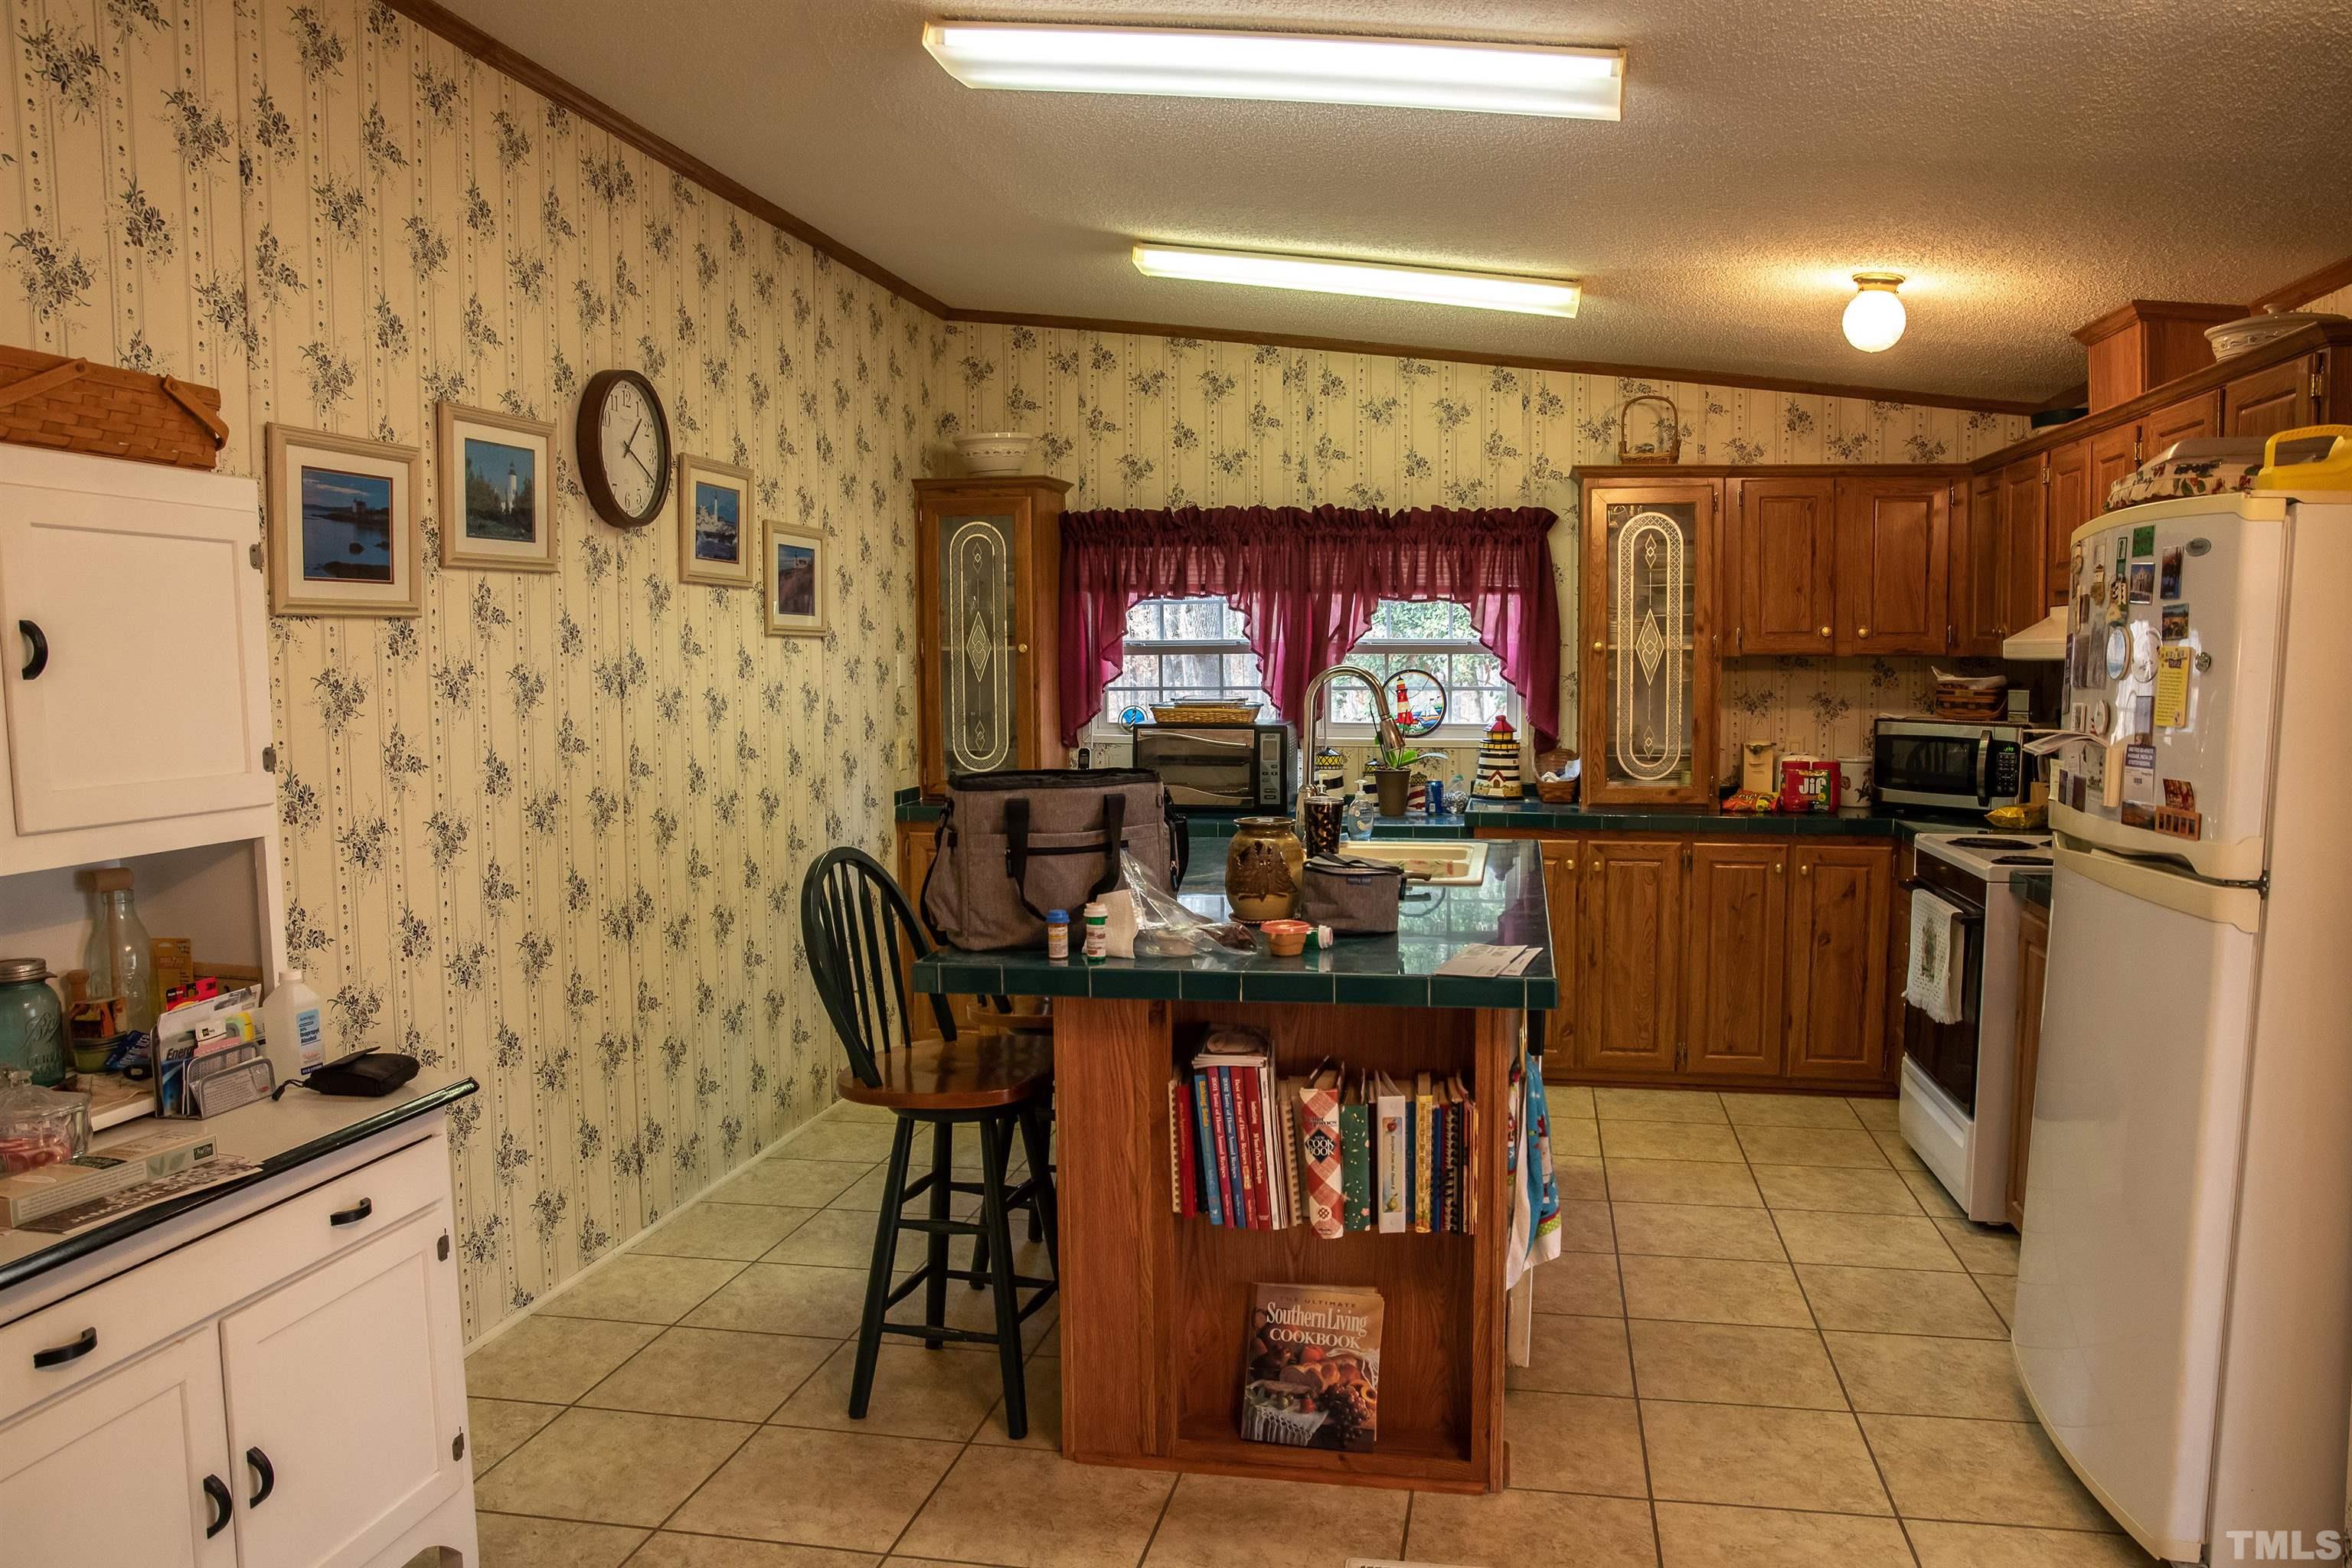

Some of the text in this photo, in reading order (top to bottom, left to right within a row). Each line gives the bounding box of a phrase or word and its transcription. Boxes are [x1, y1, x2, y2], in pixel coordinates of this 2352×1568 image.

[610, 394, 618, 411] 11
[622, 390, 631, 408] 12
[635, 401, 640, 417] 1
[603, 410, 610, 427] 10
[644, 421, 649, 437] 2
[649, 449, 654, 465] 3
[625, 492, 630, 509] 6
[636, 489, 642, 505] 5
[1798, 778, 1826, 794] Jif
[301, 1035, 316, 1044] Alcohol
[166, 1047, 194, 1061] Energ
[1236, 1100, 1244, 1115] Taste
[1238, 1124, 1246, 1142] Home
[1308, 1139, 1334, 1148] COOK
[1308, 1147, 1334, 1156] BOOK
[1240, 1142, 1249, 1165] Recipes
[1218, 1156, 1227, 1178] Recipes
[1229, 1156, 1238, 1178] Recipes
[1255, 1169, 1263, 1184] Recipes
[72, 1190, 165, 1223] JAMOCHA
[1305, 1299, 1357, 1308] ULTIMATE
[1266, 1302, 1367, 1337] Southern Living
[1269, 1328, 1360, 1349] COOKBOOK
